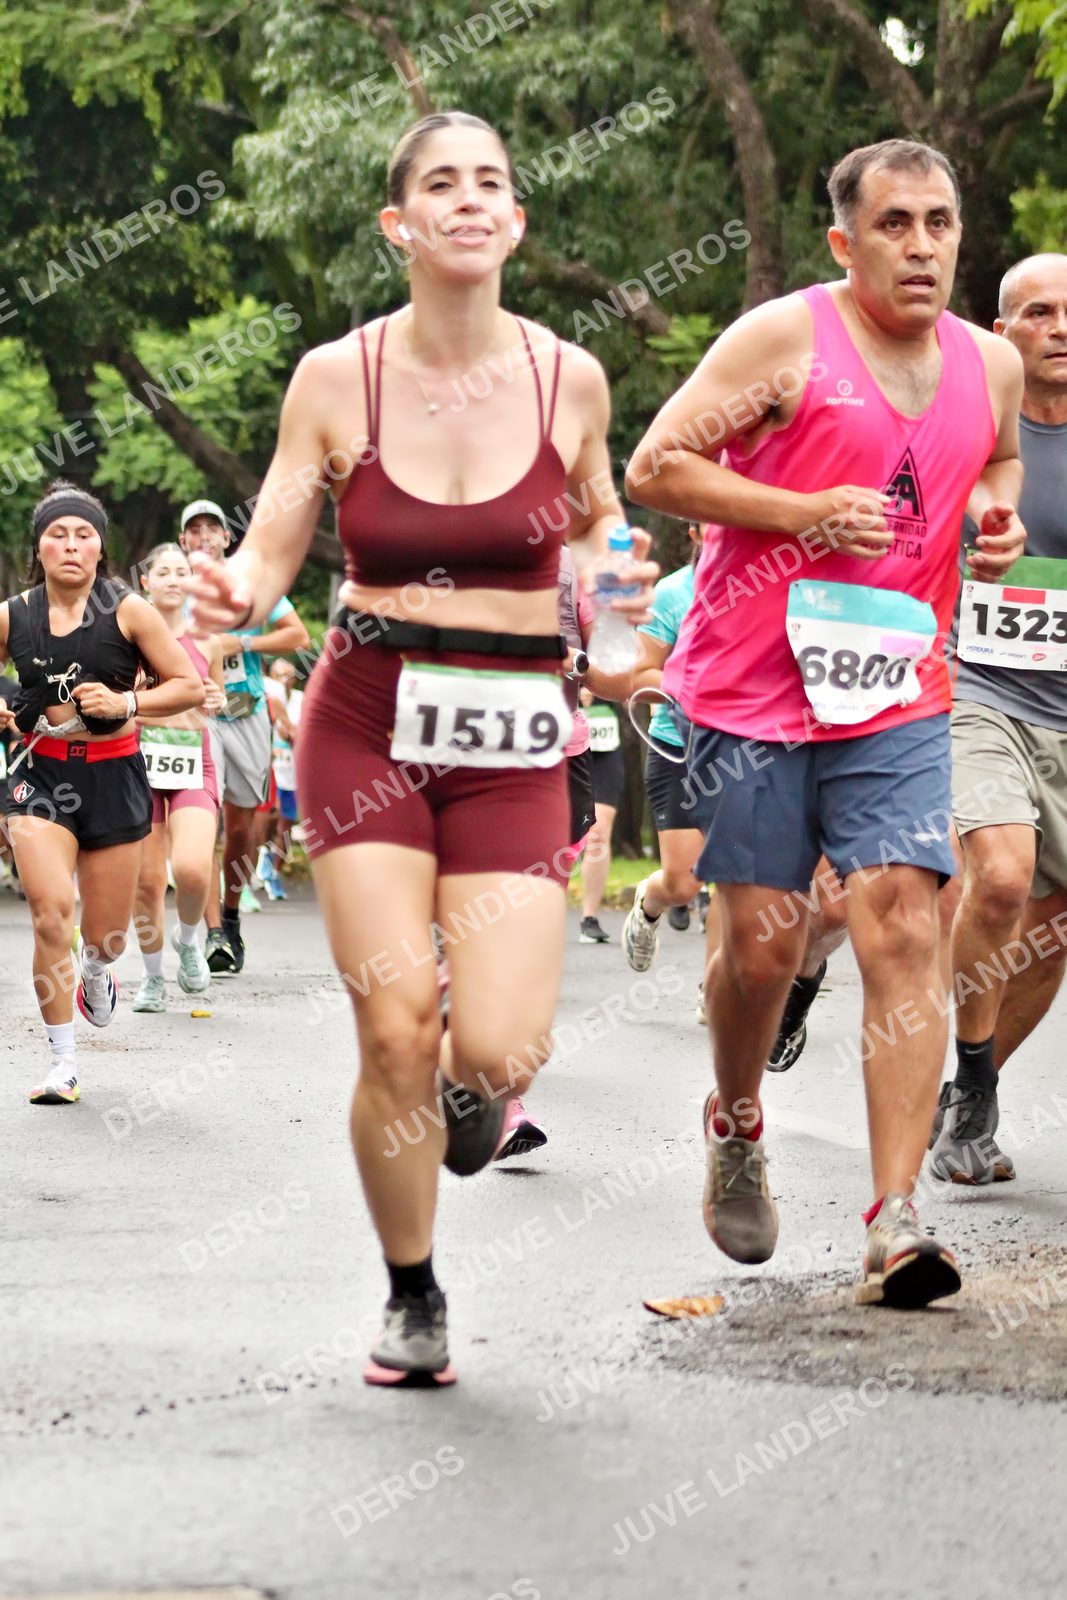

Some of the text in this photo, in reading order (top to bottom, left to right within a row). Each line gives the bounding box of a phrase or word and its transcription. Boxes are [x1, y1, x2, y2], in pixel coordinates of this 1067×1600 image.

[972, 602, 1067, 644] 1323
[796, 645, 912, 691] 6800
[416, 703, 560, 755] 1519
[145, 754, 196, 775] 1561
